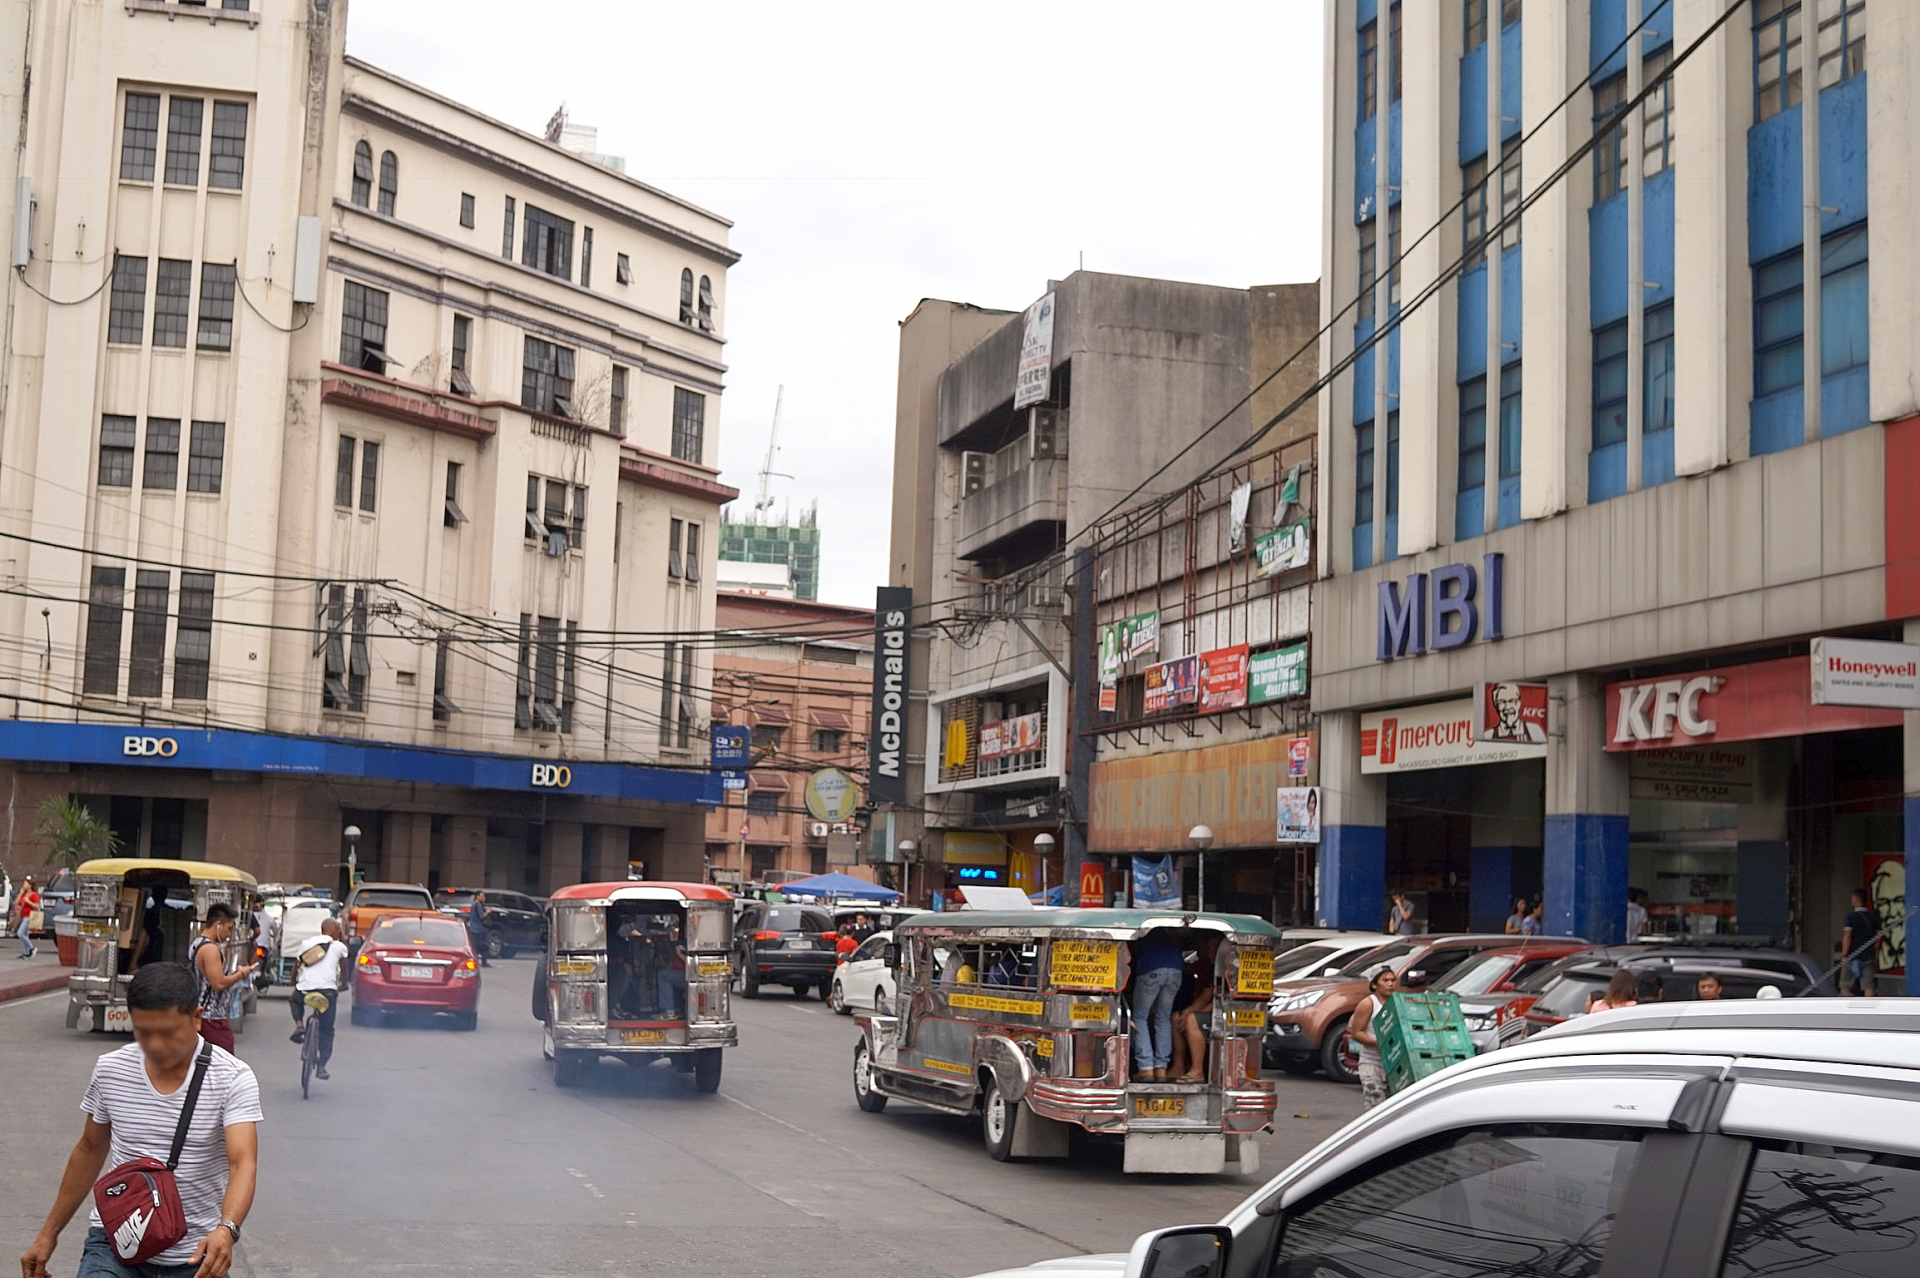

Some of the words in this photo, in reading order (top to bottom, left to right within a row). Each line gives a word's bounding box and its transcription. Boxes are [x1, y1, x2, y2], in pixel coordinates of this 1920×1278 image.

[1376, 552, 1504, 662] MBI
[1829, 656, 1916, 678] Honeywell
[878, 611, 905, 778] McDonald's
[1523, 707, 1546, 718] KFC
[1612, 675, 1717, 743] KFC
[123, 736, 178, 757] BDO
[1400, 719, 1476, 748] mercury
[532, 764, 572, 788] BDO
[107, 1009, 129, 1022] GOD
[113, 1207, 143, 1250] NIKE
